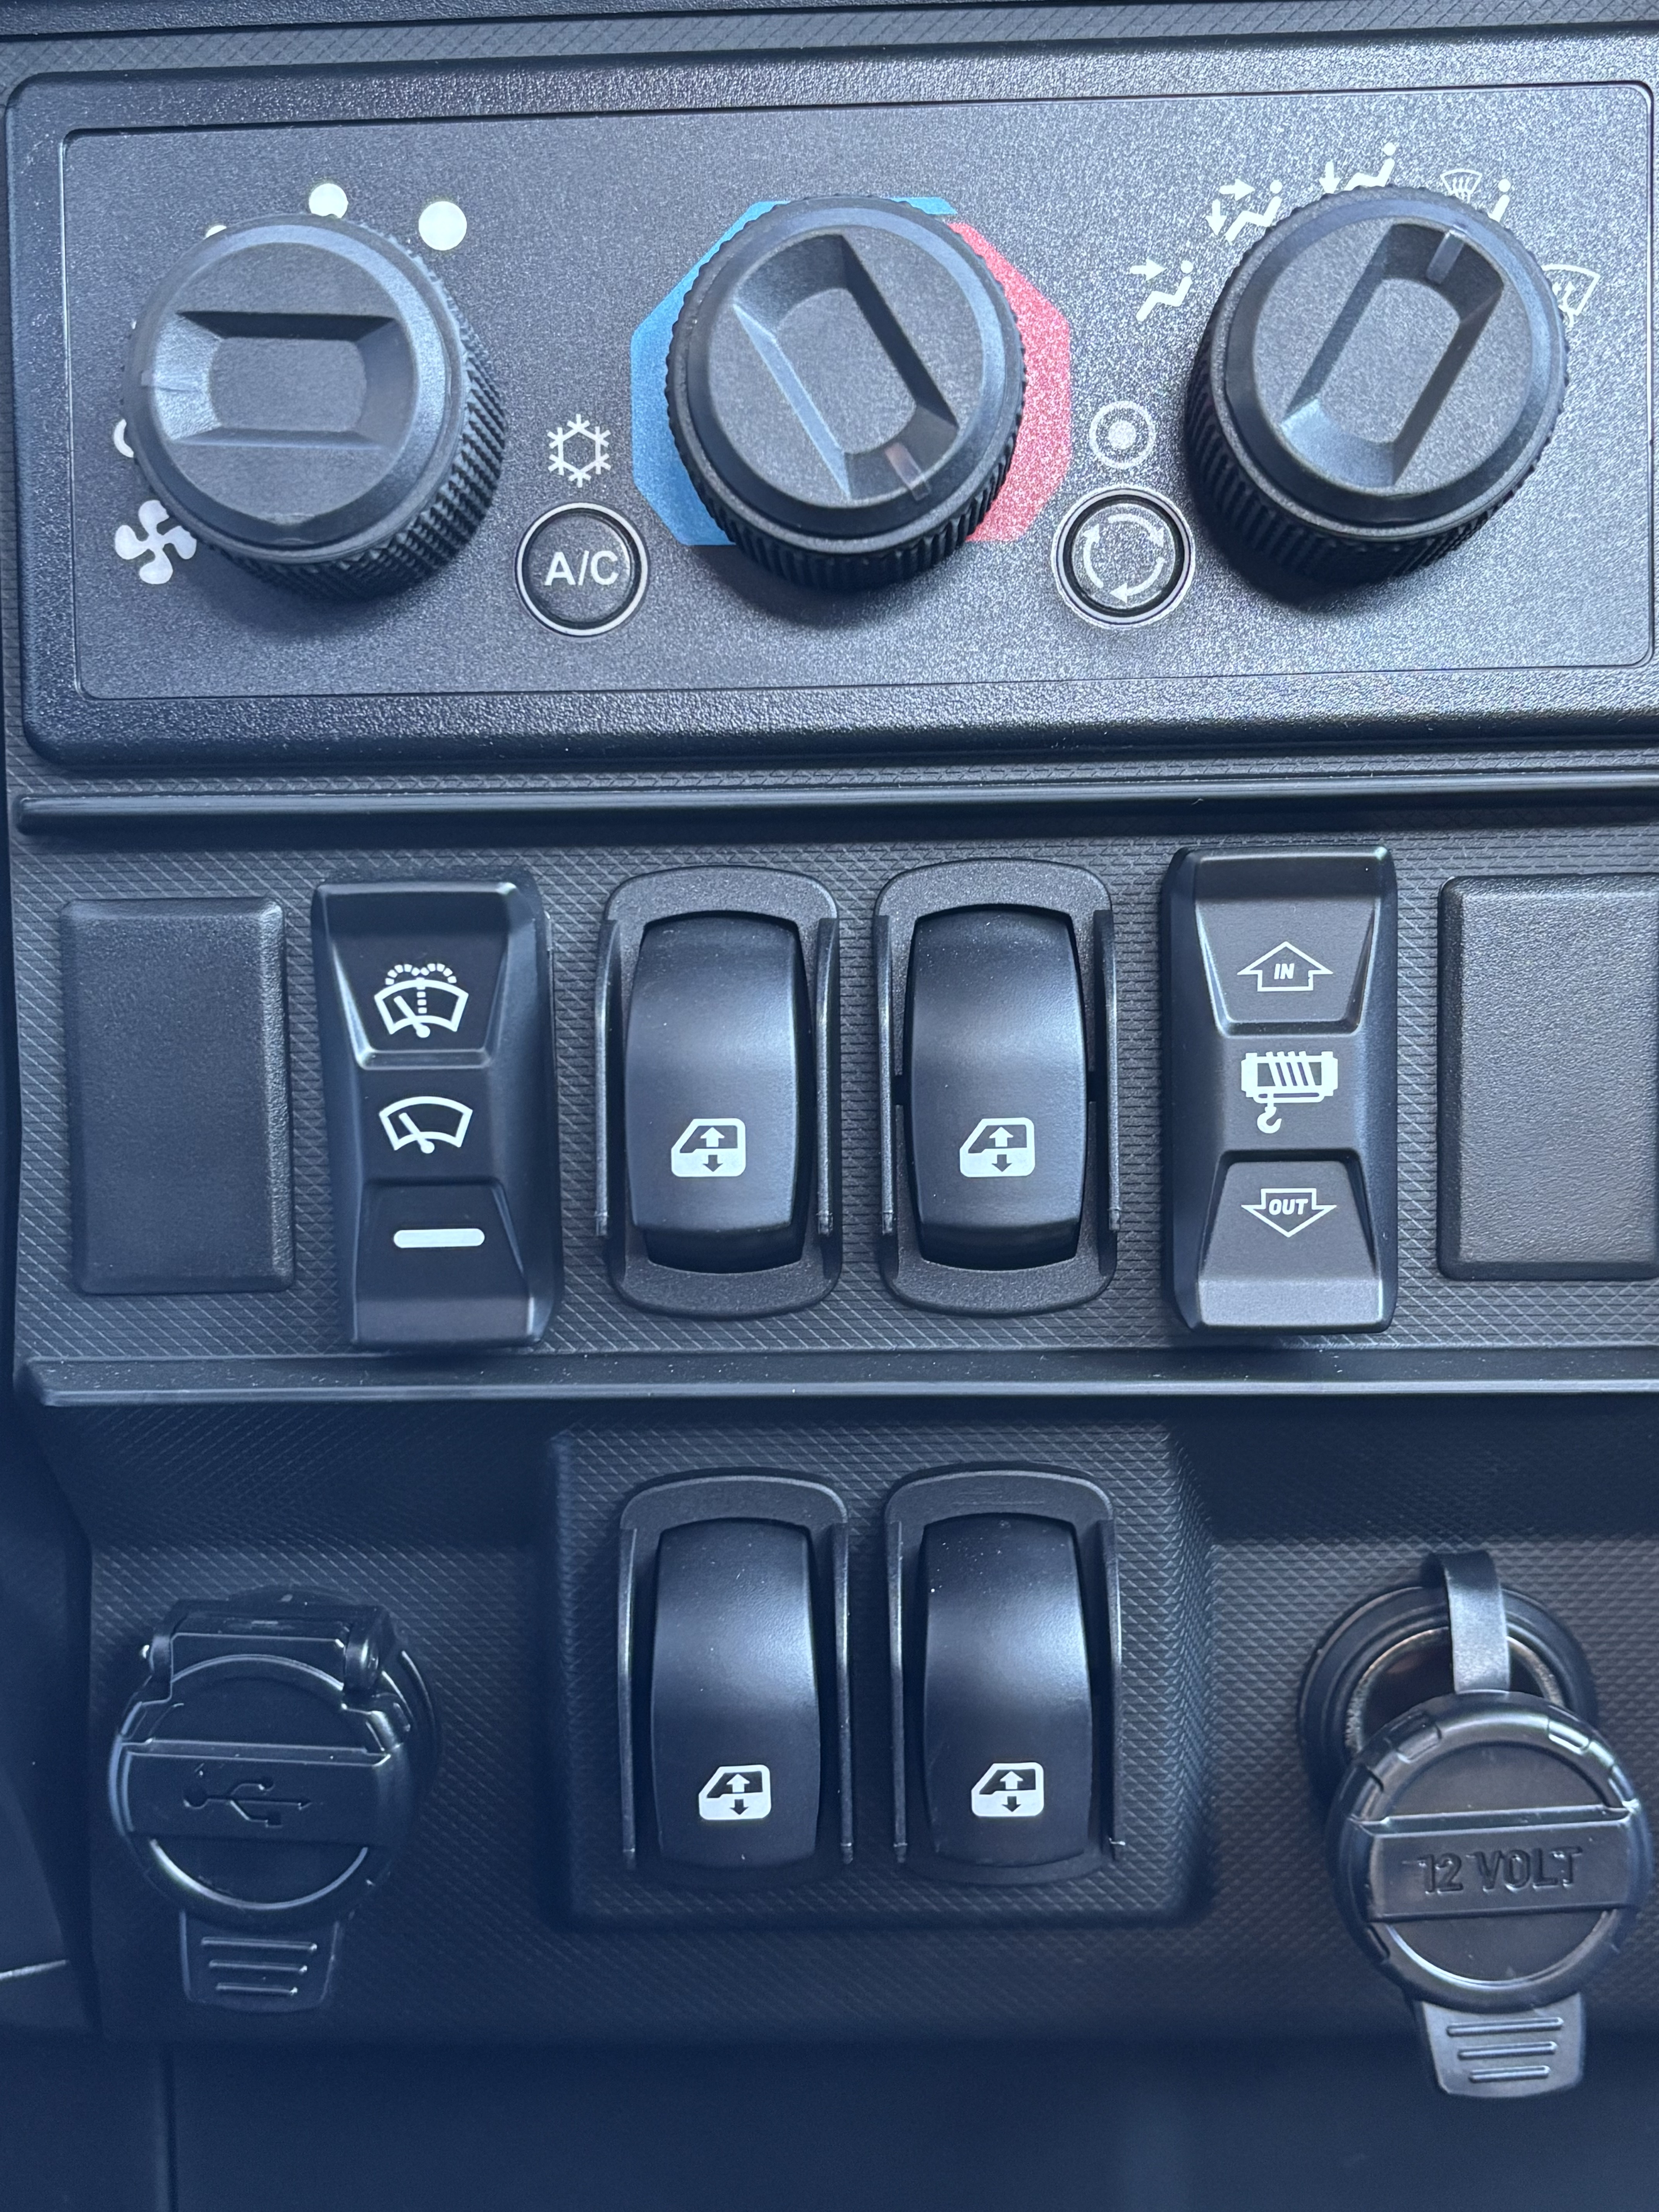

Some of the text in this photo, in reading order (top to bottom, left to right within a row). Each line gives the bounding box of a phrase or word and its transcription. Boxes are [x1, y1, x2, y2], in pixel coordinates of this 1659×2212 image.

[544, 550, 619, 586] A/C
[1274, 963, 1295, 980] IN
[1268, 1198, 1309, 1216] OUT
[1418, 1846, 1583, 1895] 12 VOLT
